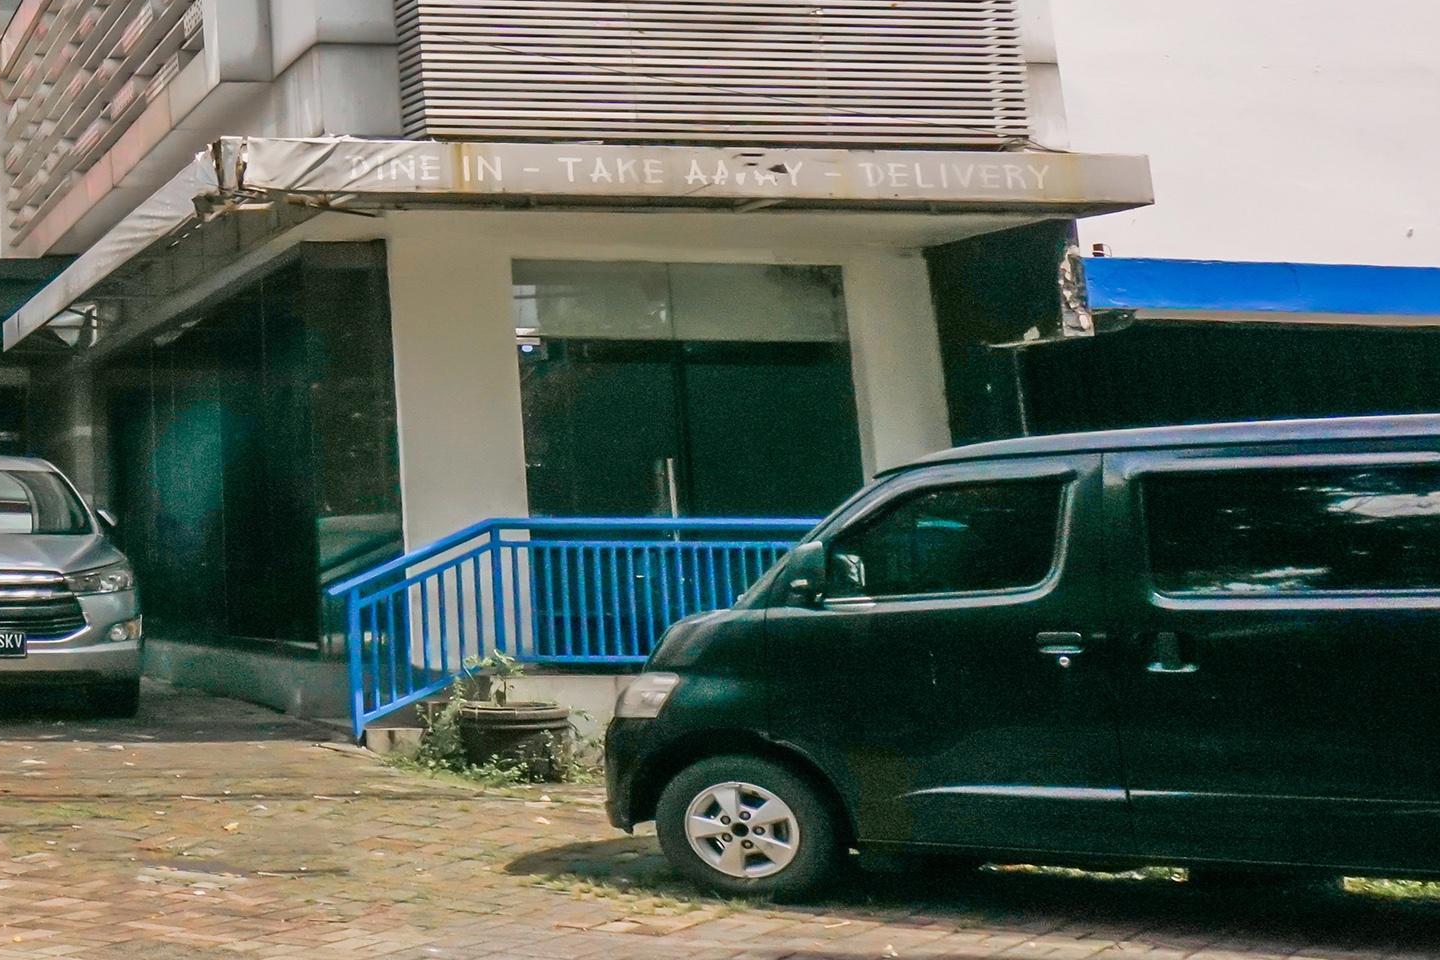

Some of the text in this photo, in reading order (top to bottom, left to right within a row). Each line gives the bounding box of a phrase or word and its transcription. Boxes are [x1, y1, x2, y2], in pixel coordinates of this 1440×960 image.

[345, 154, 441, 182] DINE
[463, 154, 502, 182] IN
[558, 157, 665, 184] TAKE
[859, 162, 1050, 190] DELIVERY
